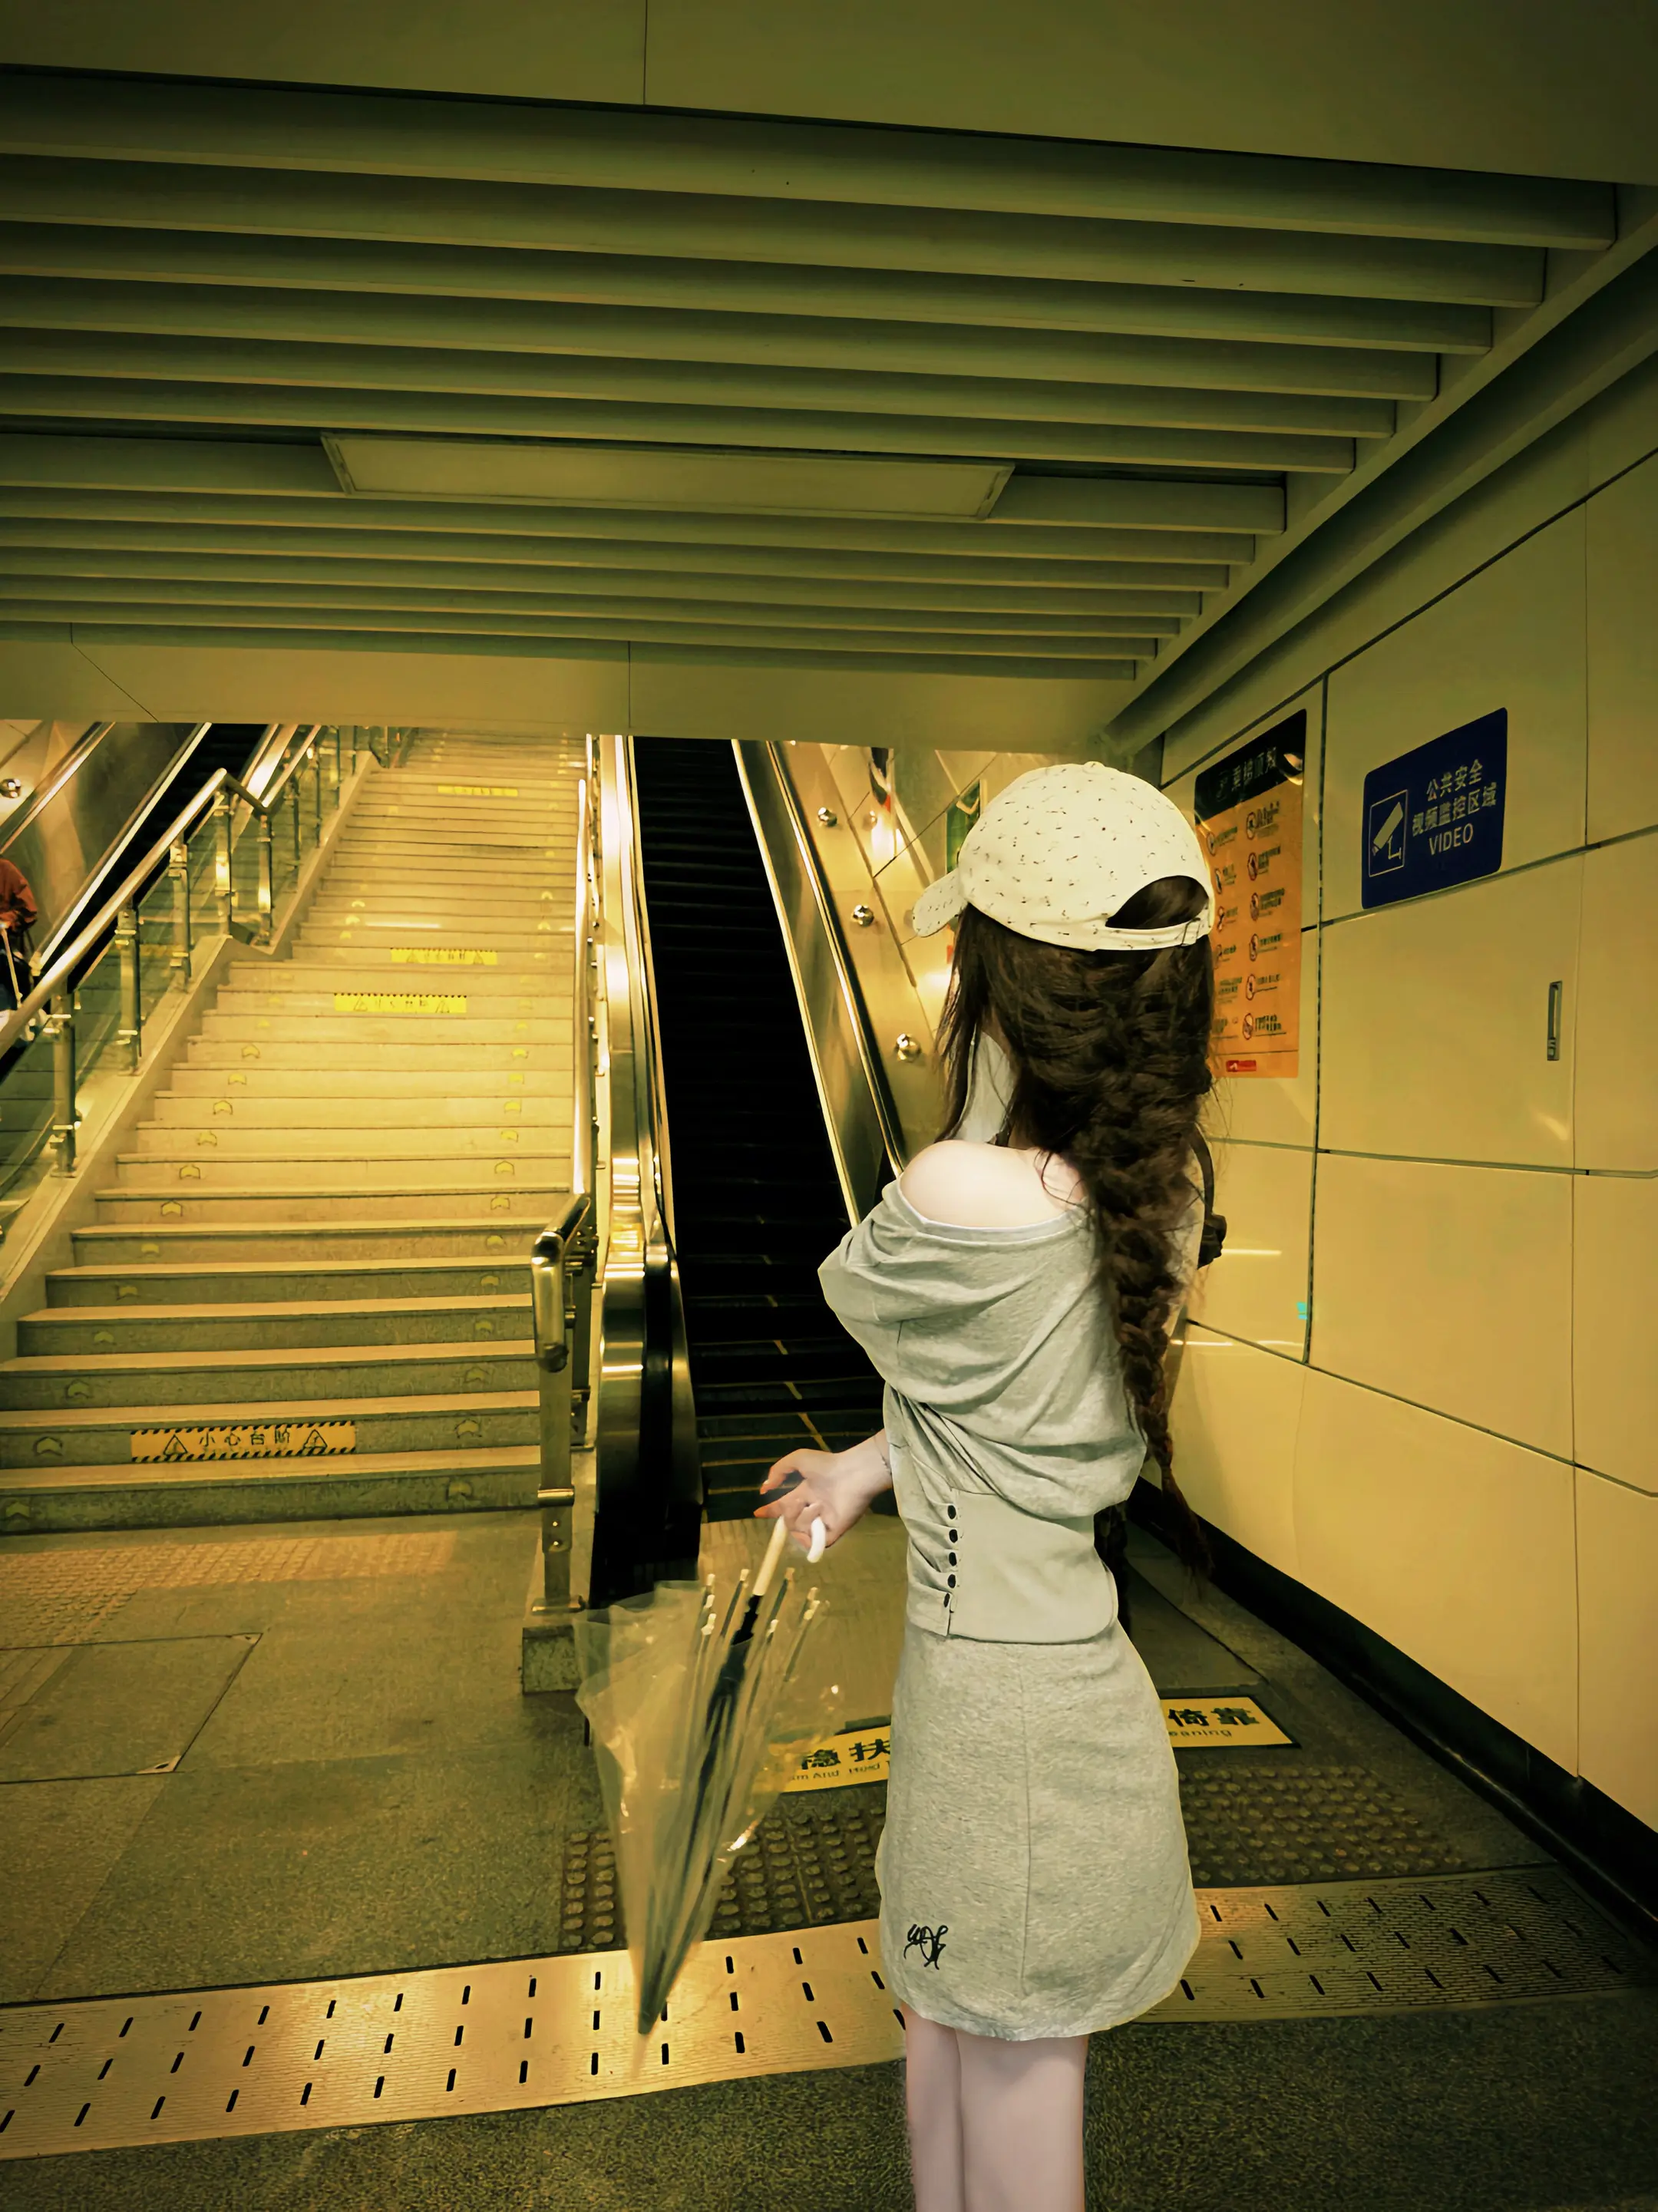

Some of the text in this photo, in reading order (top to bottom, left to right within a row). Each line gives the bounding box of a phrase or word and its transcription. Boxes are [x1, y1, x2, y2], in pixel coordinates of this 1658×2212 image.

[1426, 758, 1483, 802] 公共安全
[1412, 781, 1497, 837] 视频监控区域
[1428, 822, 1474, 856] VIDEO
[199, 1428, 290, 1448] 小心台阶
[1168, 1729, 1233, 1738] eaning
